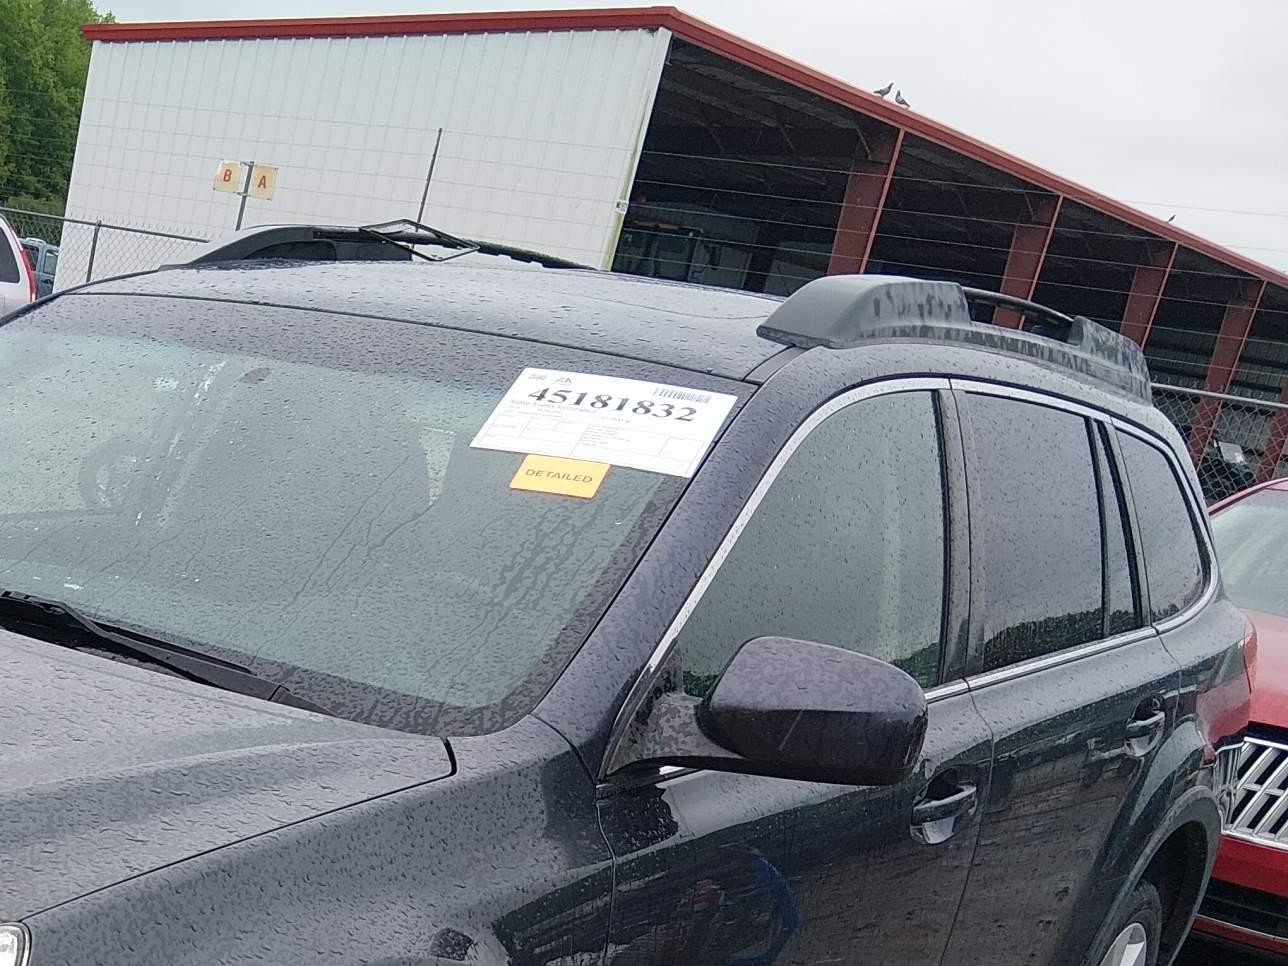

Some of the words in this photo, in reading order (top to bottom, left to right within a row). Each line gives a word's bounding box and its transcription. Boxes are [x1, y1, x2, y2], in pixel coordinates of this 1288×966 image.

[223, 169, 232, 182] B
[257, 176, 267, 188] A
[528, 387, 697, 421] 45181832
[525, 468, 594, 484] DETAILED
